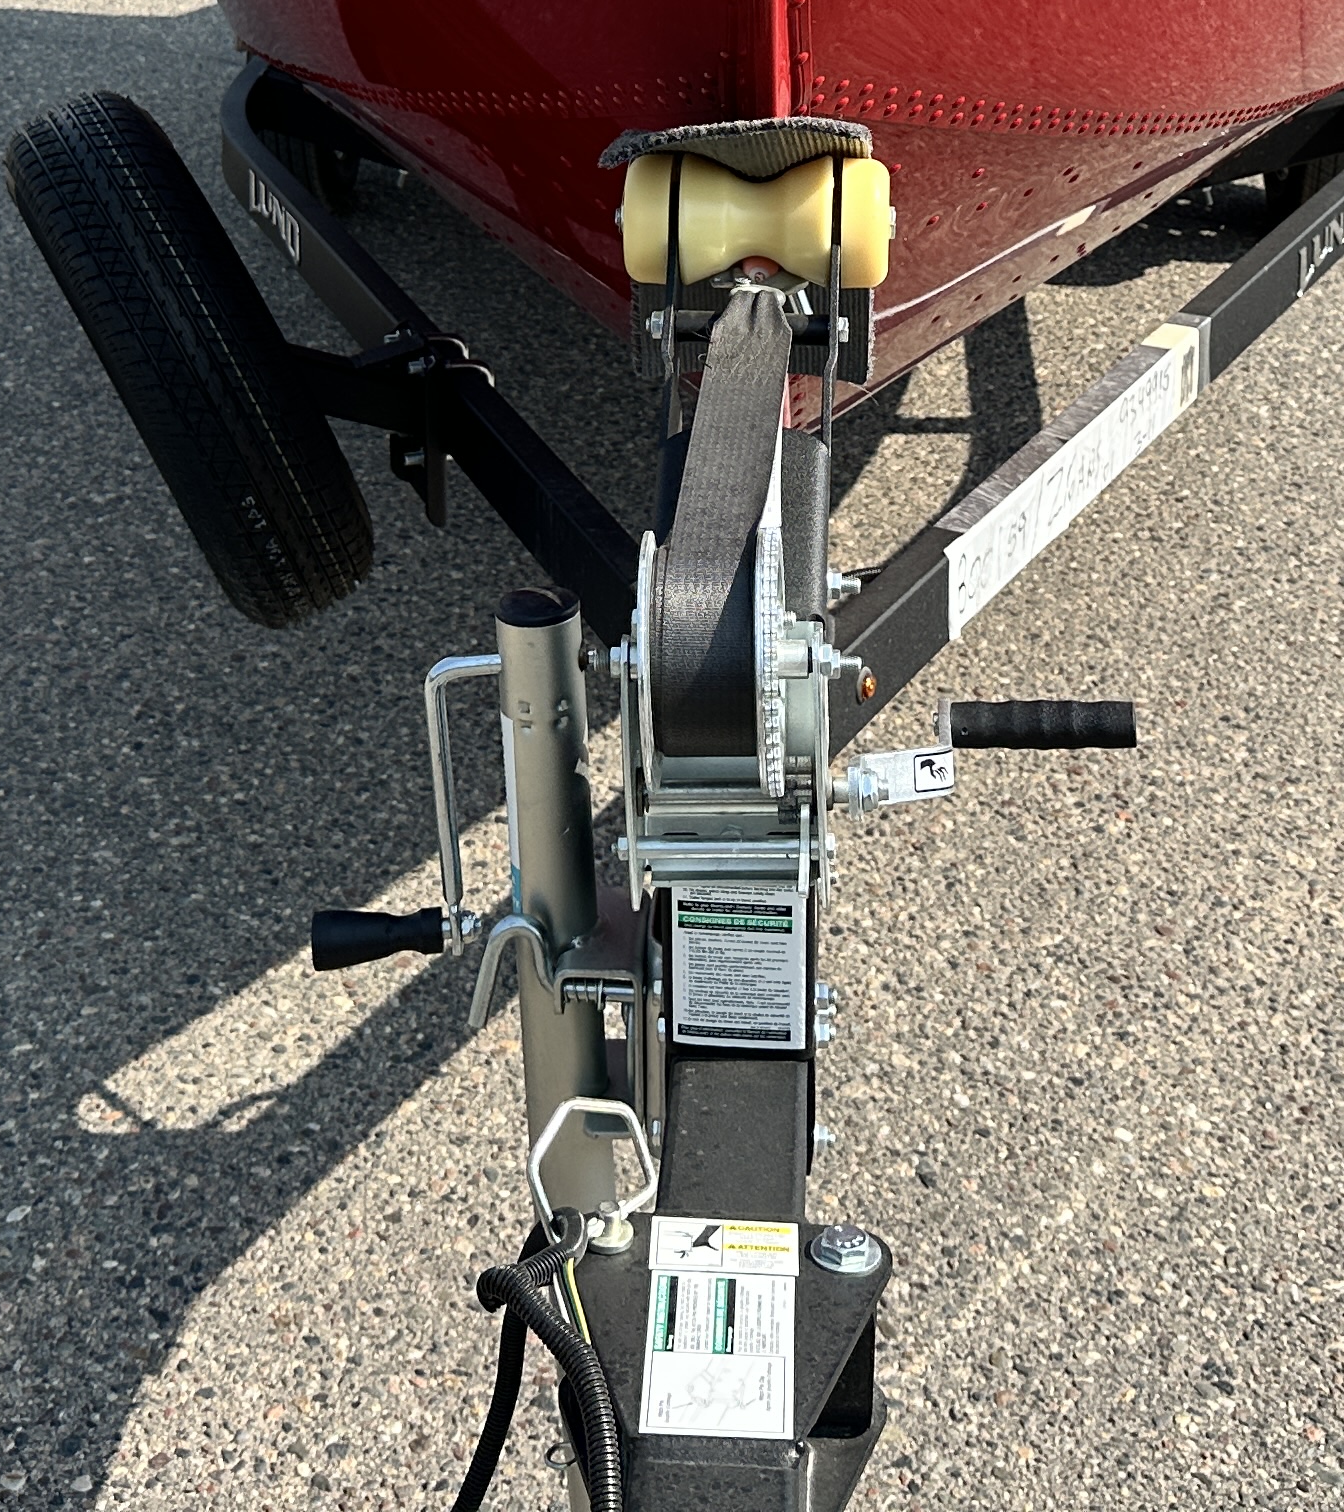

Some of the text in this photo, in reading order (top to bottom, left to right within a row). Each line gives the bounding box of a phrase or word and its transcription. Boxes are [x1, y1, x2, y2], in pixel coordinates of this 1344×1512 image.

[249, 168, 299, 265] LUND
[733, 918, 746, 926] DE
[738, 1244, 790, 1252] ATTENTION
